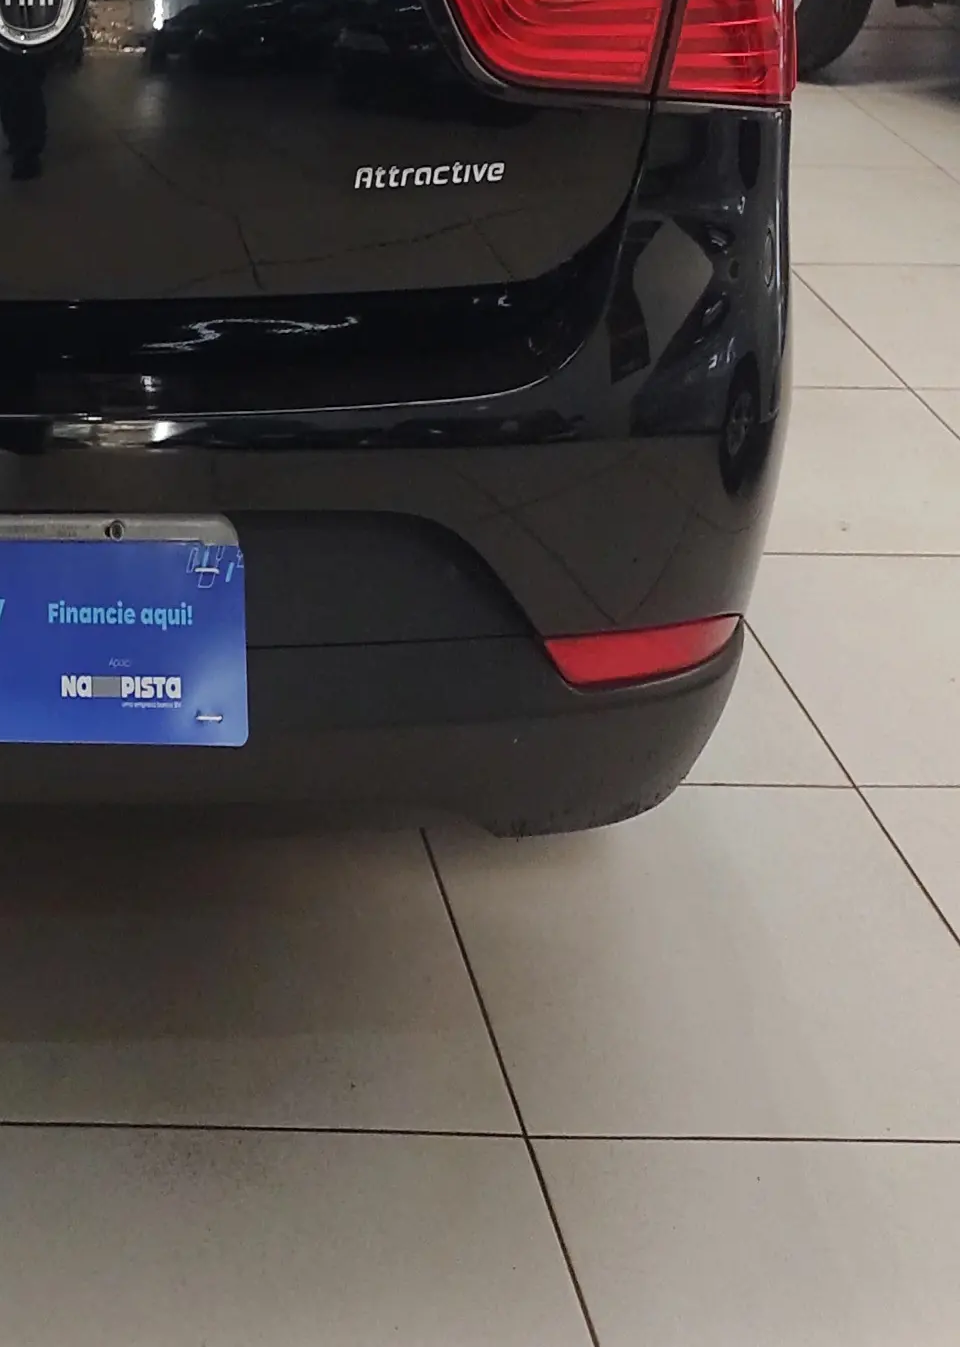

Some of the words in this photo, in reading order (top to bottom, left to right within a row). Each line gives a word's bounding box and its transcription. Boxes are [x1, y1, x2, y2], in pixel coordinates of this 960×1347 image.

[354, 161, 505, 189] Attractive
[47, 600, 136, 625] Financie
[140, 601, 194, 631] aqui!
